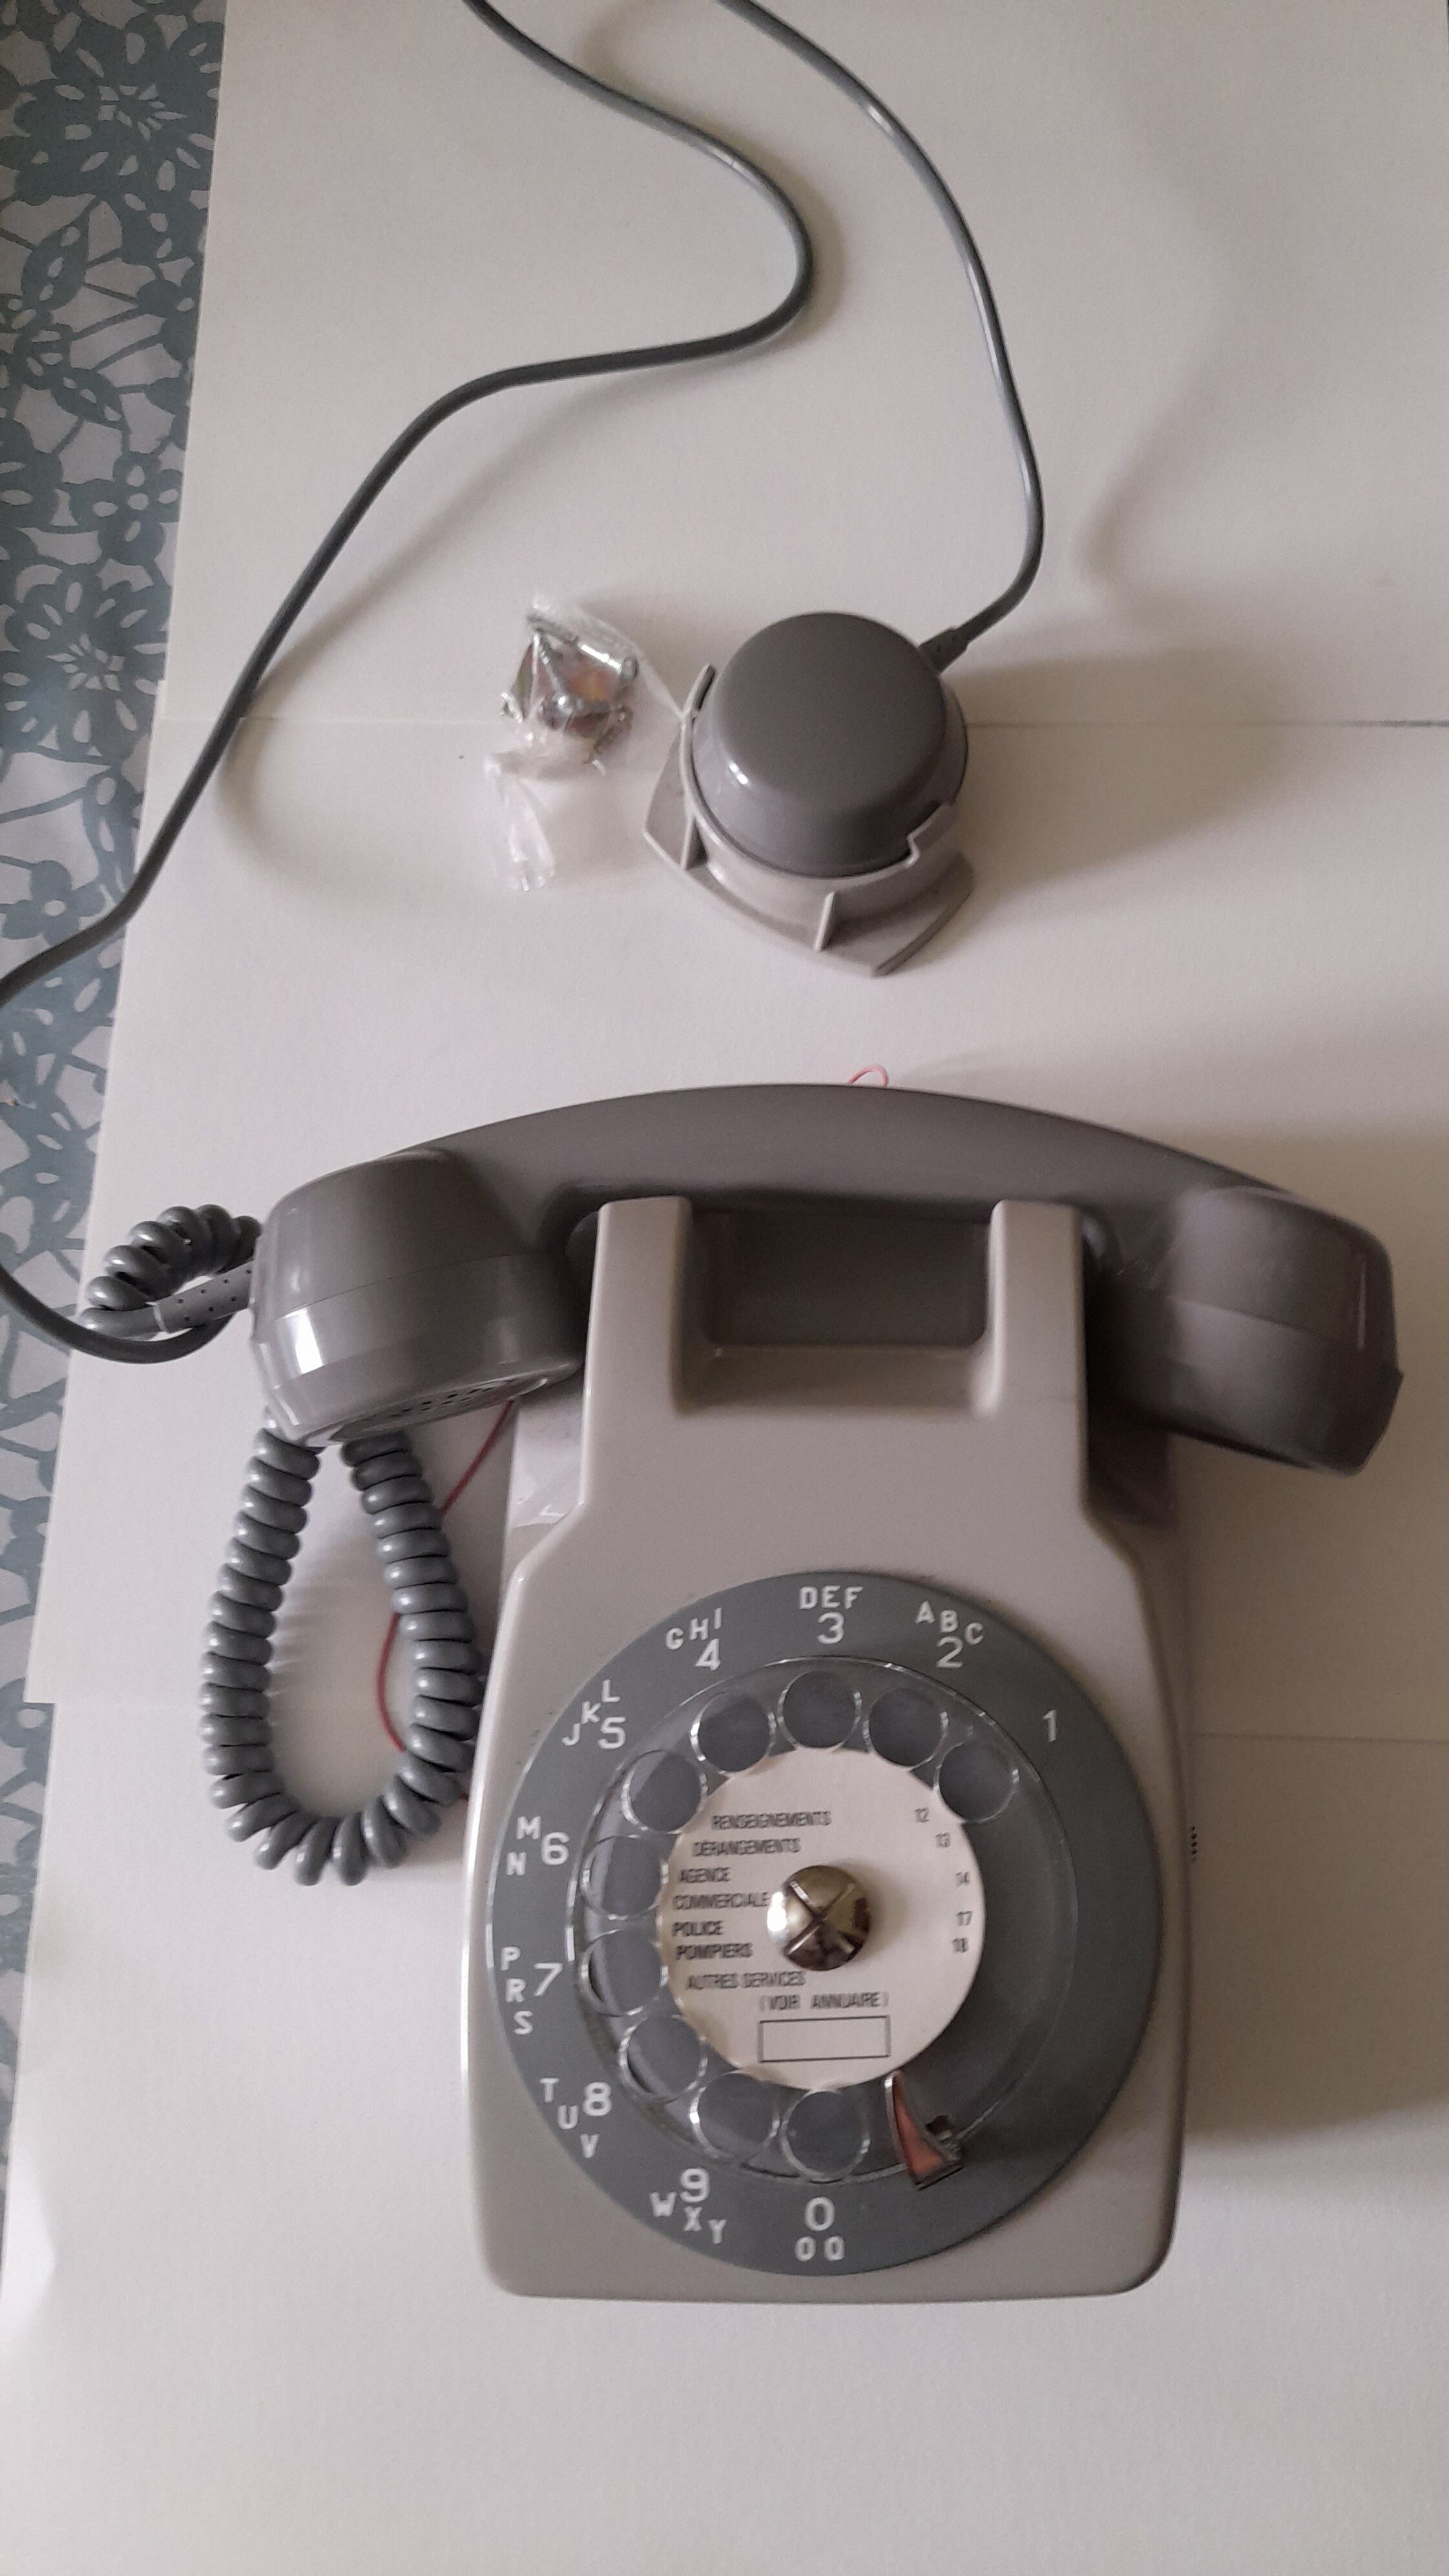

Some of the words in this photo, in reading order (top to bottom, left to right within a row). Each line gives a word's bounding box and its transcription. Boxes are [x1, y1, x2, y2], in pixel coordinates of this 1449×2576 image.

[817, 1612, 845, 1644] 3
[694, 1638, 722, 1671] 4
[936, 1636, 964, 1669] 2
[598, 1716, 627, 1749] 5
[1041, 1709, 1058, 1742] 1
[712, 1811, 832, 1830] RENSEIGNEMENTS
[914, 1807, 930, 1823] 12
[541, 1832, 570, 1865] 6
[679, 1867, 731, 1884] AGENCE
[672, 1892, 769, 1910] COMMERCIALE
[672, 1920, 724, 1937] POLICE
[956, 1910, 972, 1926] 17
[675, 1942, 754, 1960] POMPIERS
[534, 1962, 562, 1997] 7
[685, 1973, 739, 1990] AUTRES
[742, 1971, 807, 1988] SERVICES
[583, 2081, 612, 2116] 8
[680, 2168, 710, 2203] 9
